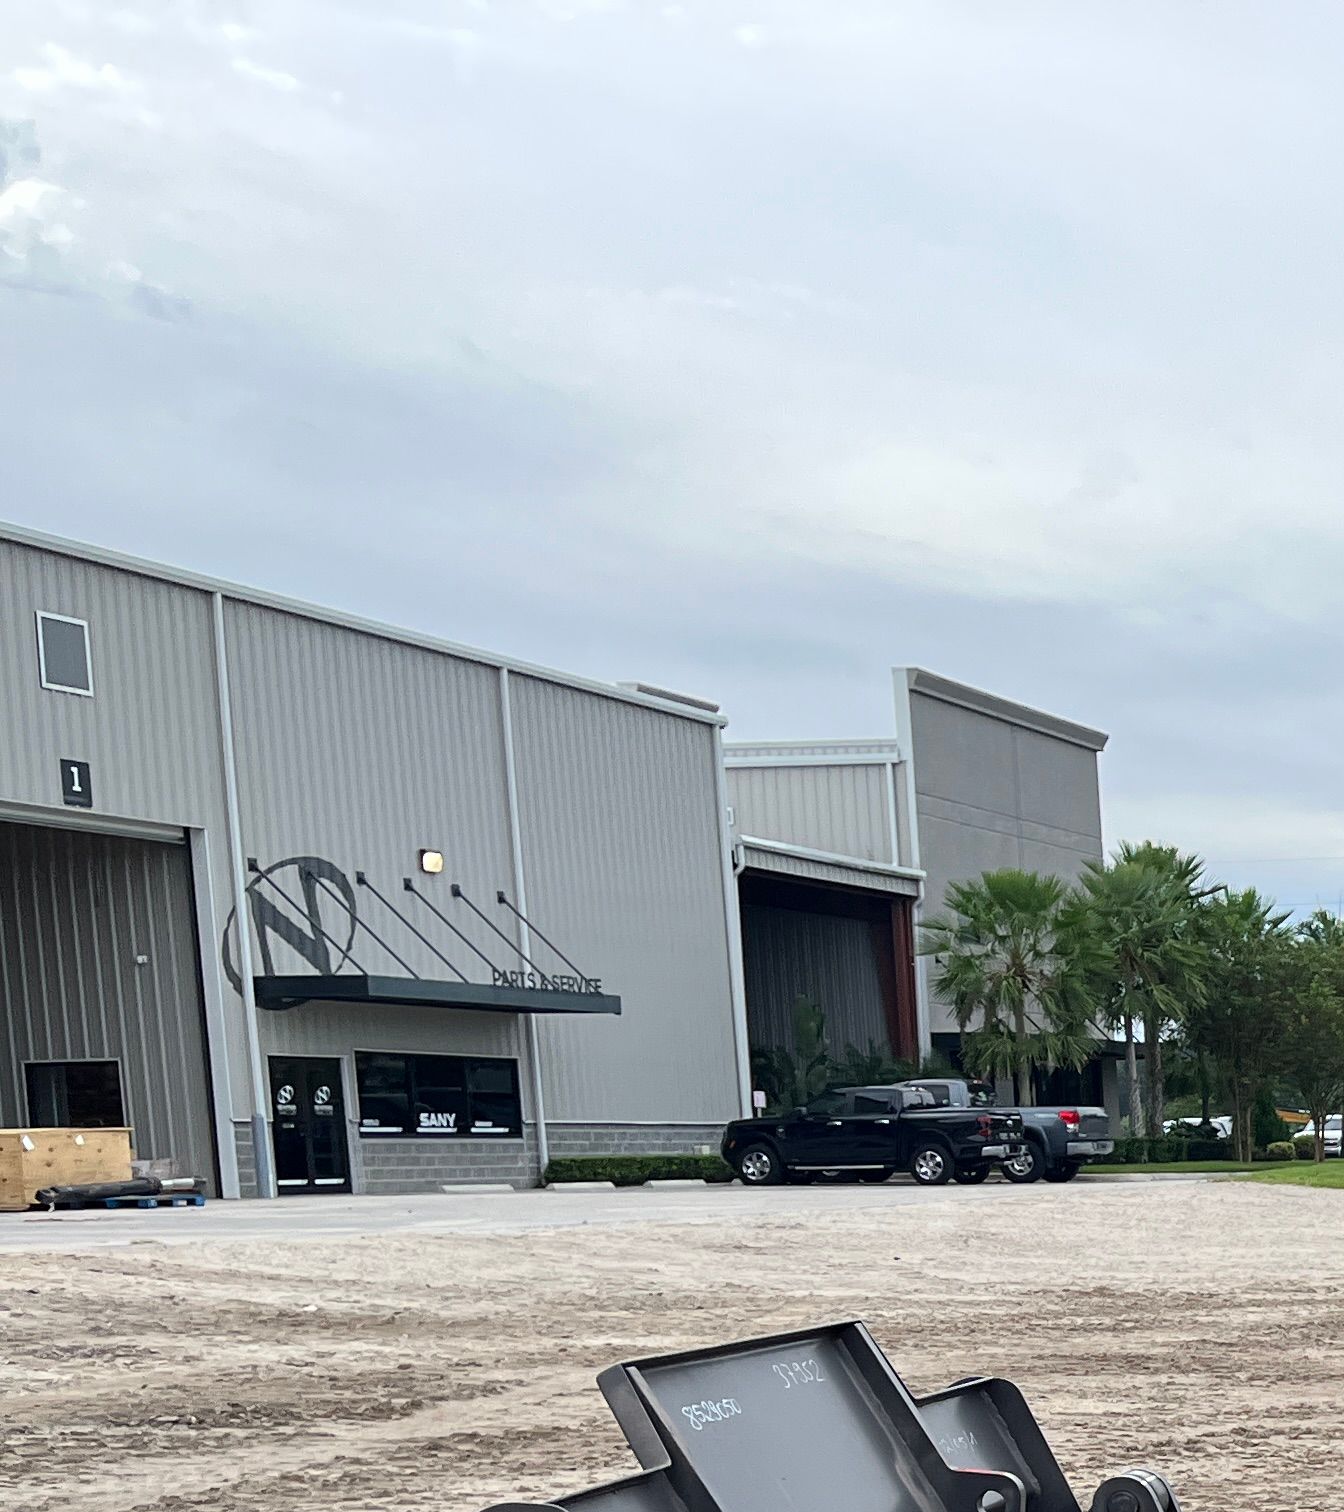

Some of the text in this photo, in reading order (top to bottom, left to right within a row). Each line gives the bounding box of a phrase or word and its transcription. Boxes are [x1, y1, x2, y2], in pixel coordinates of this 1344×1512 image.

[70, 766, 82, 792] 1
[493, 968, 536, 989] PARTS
[419, 1112, 456, 1127] SANY
